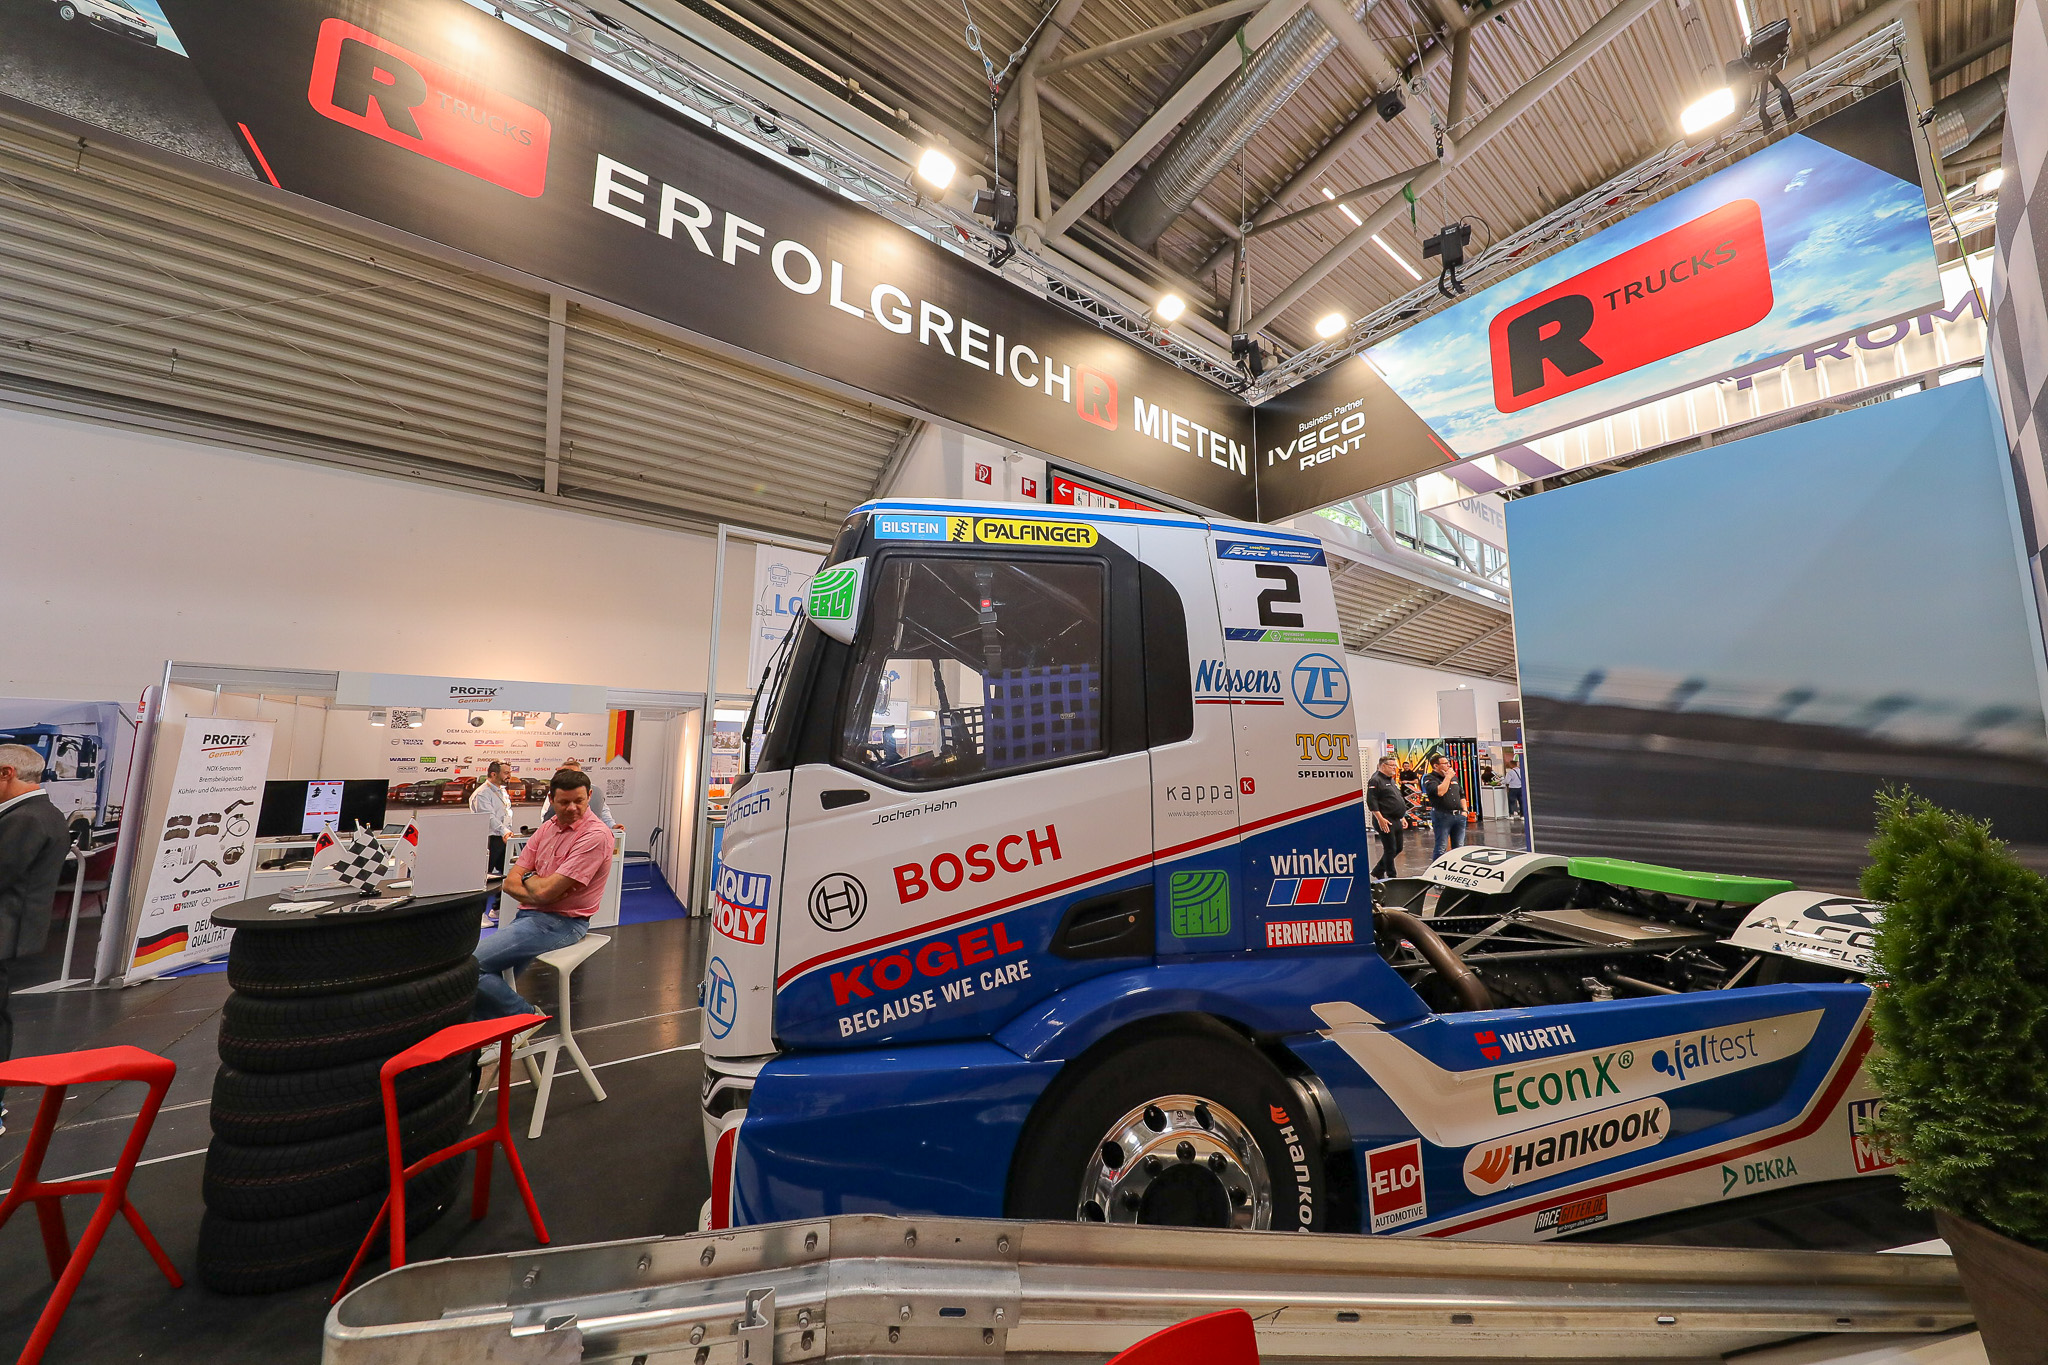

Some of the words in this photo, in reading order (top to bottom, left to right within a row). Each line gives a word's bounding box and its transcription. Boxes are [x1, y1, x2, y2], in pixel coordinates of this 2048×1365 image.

[436, 91, 533, 147] TRUCKS
[1603, 239, 1737, 311] TRUCKS
[592, 153, 1071, 404] ERFOLGREICH
[1133, 395, 1248, 477] MIETEN
[1299, 412, 1333, 433] Business
[1333, 397, 1365, 417] Partner
[1268, 411, 1366, 467] IVECO
[1299, 433, 1366, 471] RENT
[881, 521, 940, 535] BILSTEIN
[983, 522, 1091, 544] PALFINGER
[809, 590, 853, 619] EBLA
[1254, 563, 1305, 628] 2
[1194, 659, 1282, 694] Nissens
[208, 750, 245, 759] Germany
[1296, 733, 1351, 761] TCT
[1297, 770, 1354, 779] SPEDITION
[1166, 784, 1234, 804] kappa
[872, 808, 921, 826] Jochen
[924, 800, 958, 814] Hahn
[1167, 808, 1235, 818] www.kappa-optronics.com
[892, 823, 1062, 905] BOSCH
[1269, 847, 1358, 876] winkler
[1432, 860, 1505, 883] ALCOA
[217, 879, 241, 889] DAF
[1444, 873, 1479, 887] WHEELS
[713, 896, 767, 941] MOLY
[1173, 896, 1228, 935] EBLA
[191, 928, 228, 948] QUALITÄT
[1266, 921, 1354, 946] FERNFAHRER
[829, 921, 1025, 1007] KÖGEL
[838, 989, 937, 1038] BECAUSE
[940, 977, 975, 1003] WE
[980, 959, 1032, 991] CARE
[1500, 1023, 1577, 1054] WÜRTH
[1674, 1028, 1759, 1081] jaltest
[1374, 1163, 1417, 1196] ELO
[1743, 1155, 1799, 1186] DEKRA
[1375, 1206, 1424, 1228] AUTOMOTIVE
